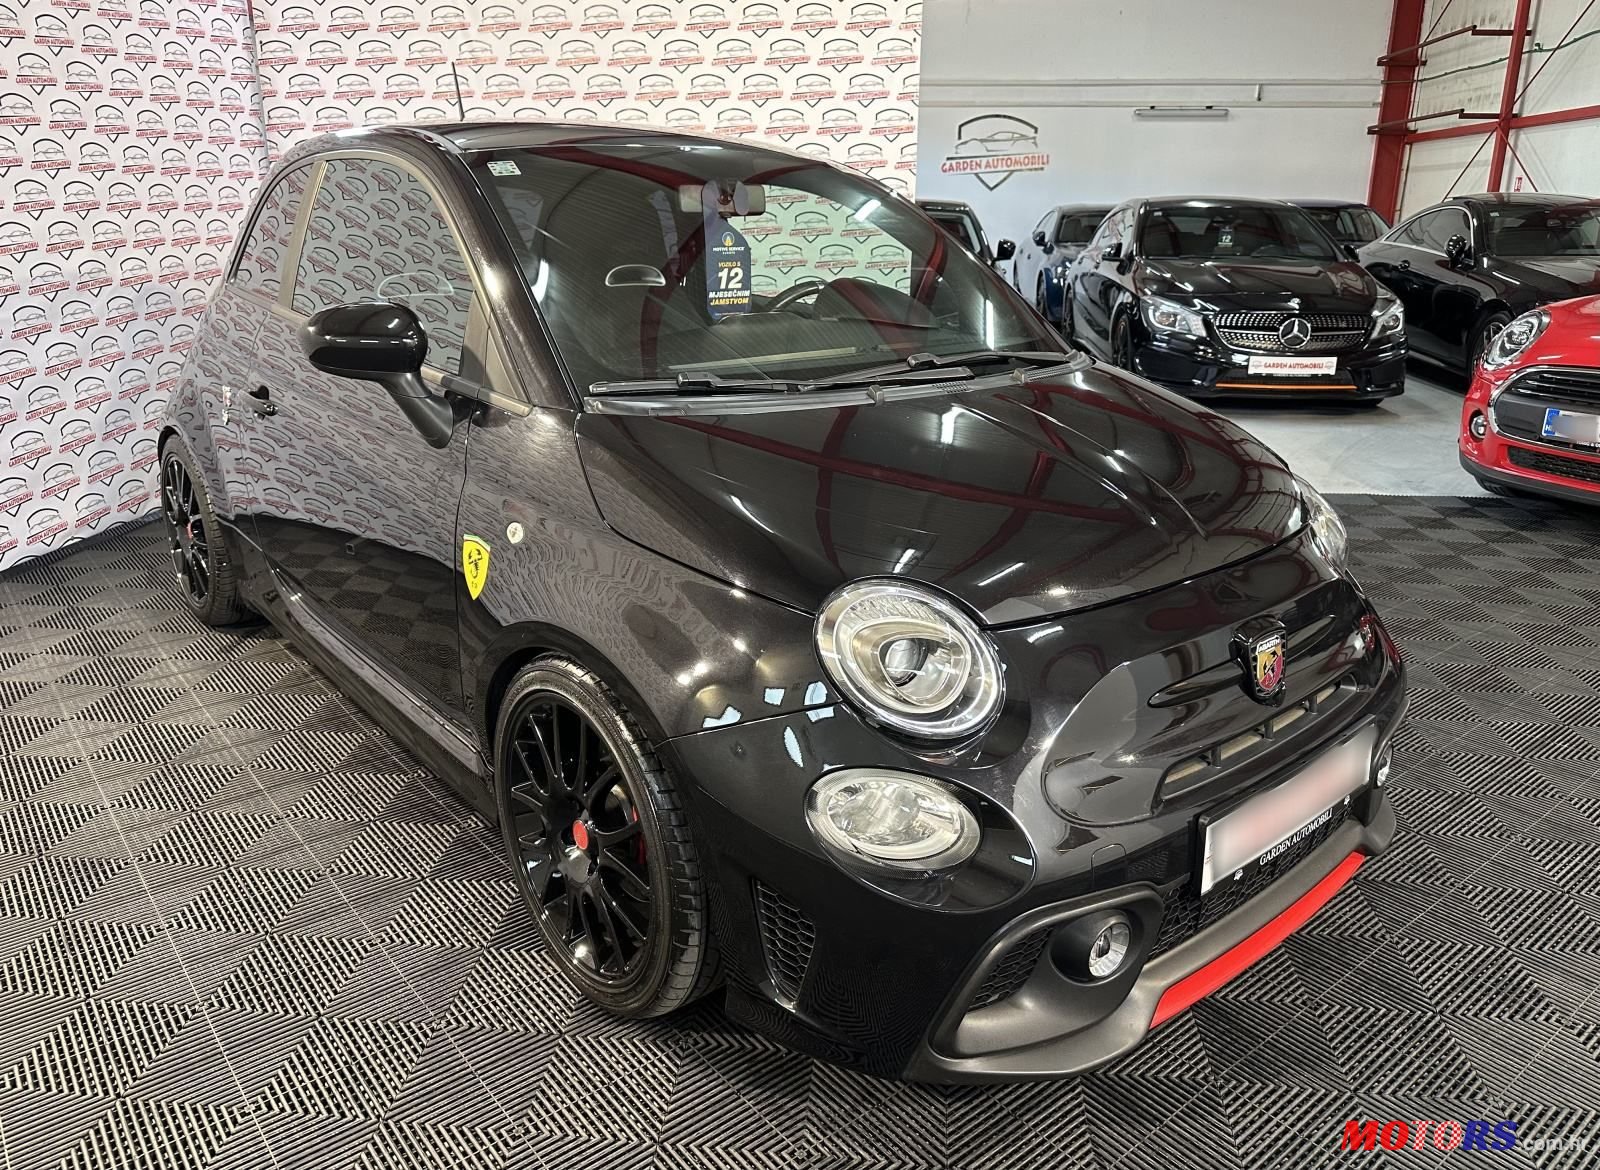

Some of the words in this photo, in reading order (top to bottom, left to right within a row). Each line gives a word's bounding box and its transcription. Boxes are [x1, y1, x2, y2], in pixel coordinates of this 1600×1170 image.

[941, 159, 982, 173] GARDEN
[984, 154, 1049, 169] AUTOMOBILI
[718, 267, 743, 289] 12
[708, 290, 750, 298] MJESEČNIM
[710, 297, 749, 306] JAMSTVOM
[1259, 638, 1281, 652] ABARTH
[1260, 837, 1292, 866] GARDEN
[1291, 808, 1333, 846] AUTOMOBILI
